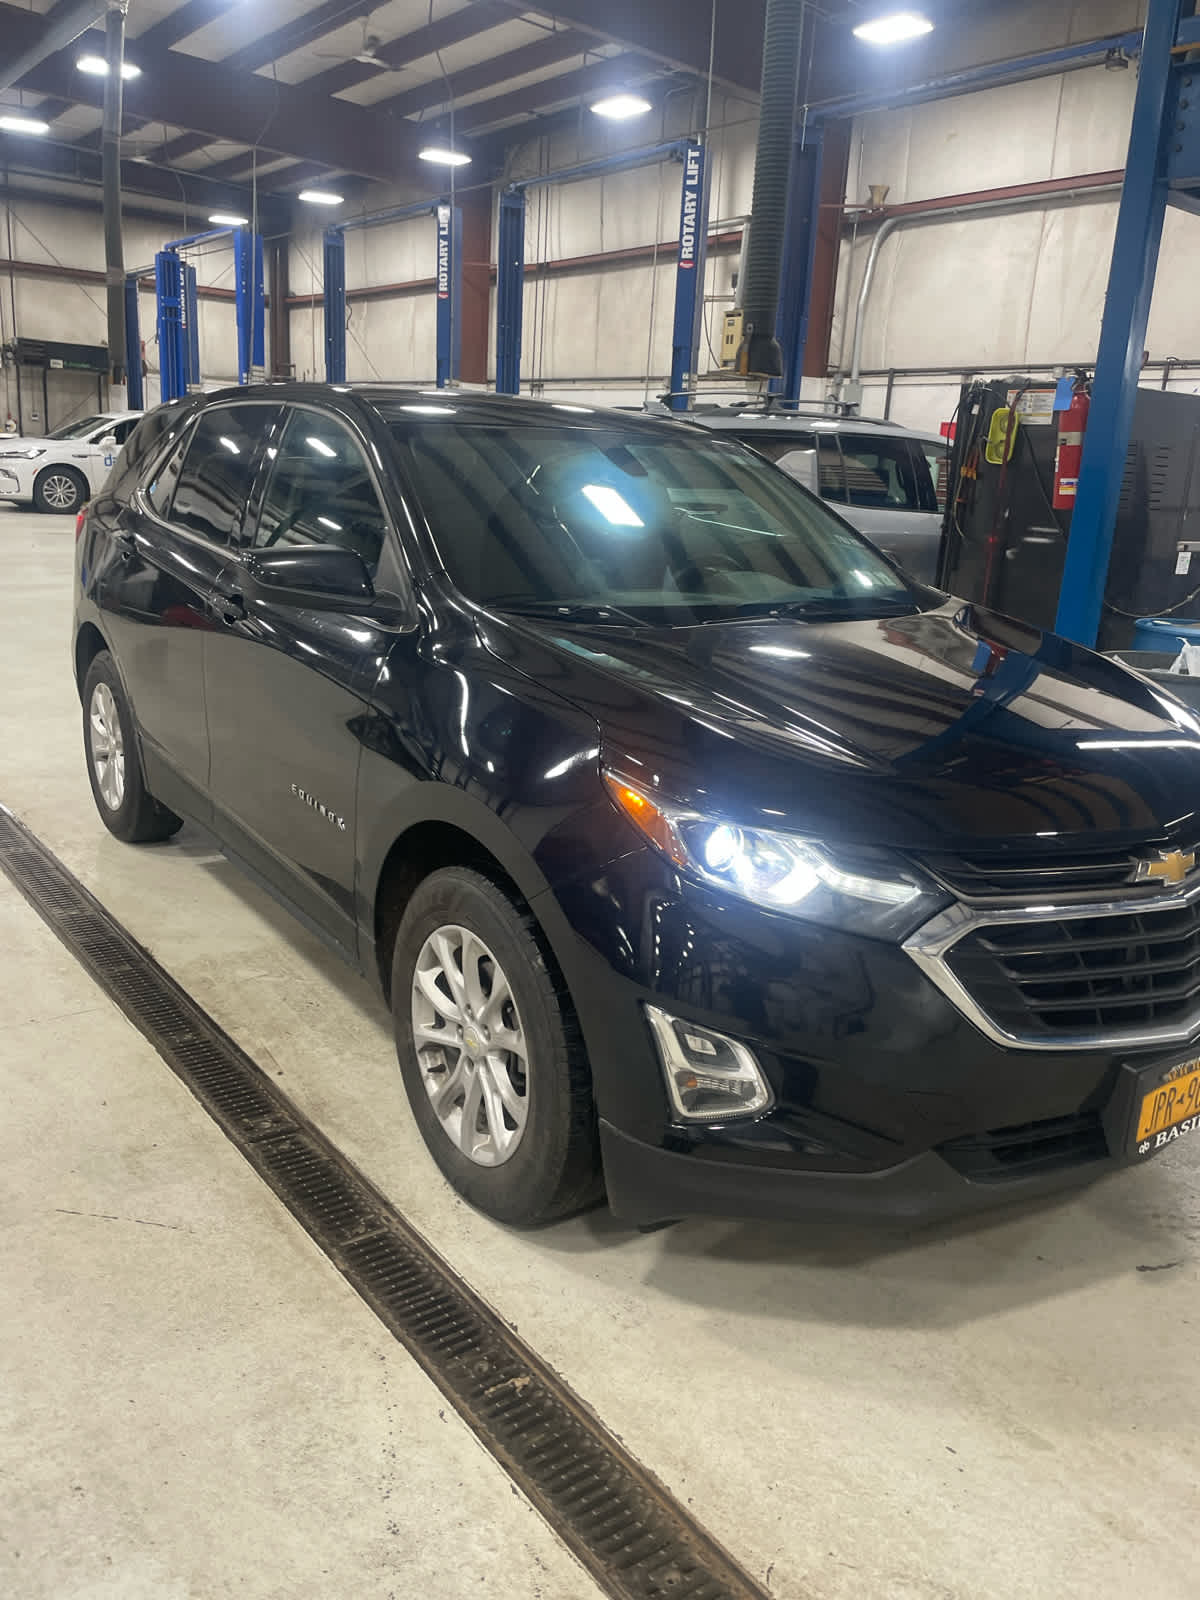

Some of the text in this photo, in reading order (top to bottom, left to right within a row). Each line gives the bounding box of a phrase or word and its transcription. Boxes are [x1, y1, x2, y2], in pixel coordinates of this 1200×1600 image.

[686, 148, 700, 185] LIFT
[682, 191, 697, 259] ROTARY
[439, 239, 448, 292] ROTARY
[291, 783, 346, 831] EQUINOX
